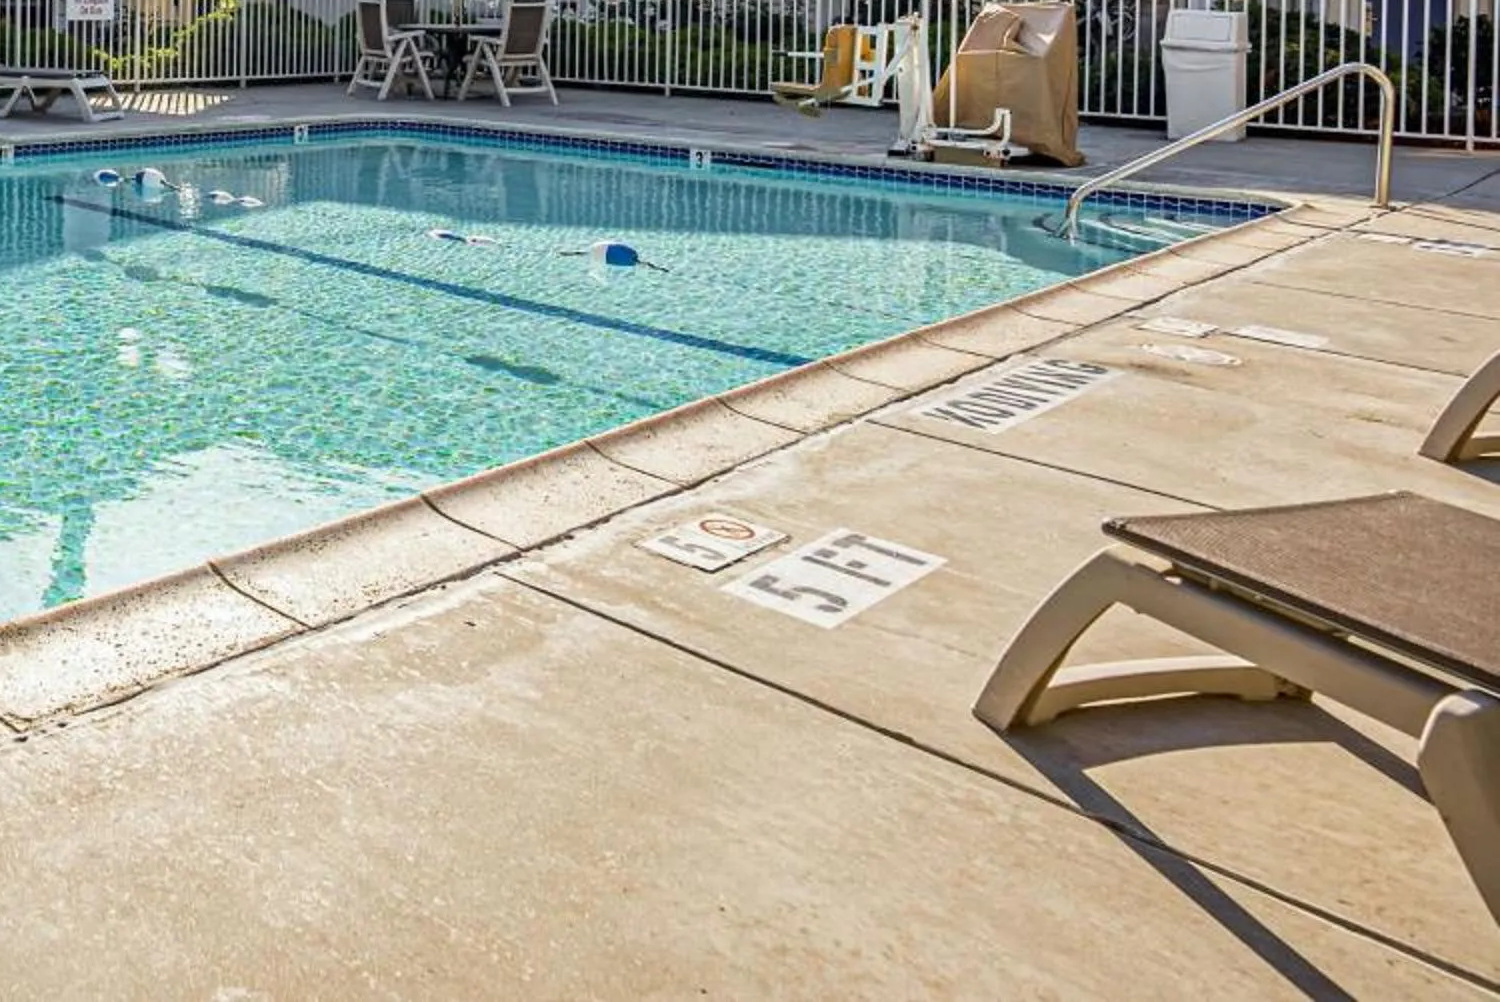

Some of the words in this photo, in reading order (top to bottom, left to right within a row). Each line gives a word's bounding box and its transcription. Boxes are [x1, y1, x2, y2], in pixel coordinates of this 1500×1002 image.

[968, 359, 1109, 411] DIVING
[921, 400, 1016, 429] NO
[659, 535, 727, 561] 5
[749, 574, 848, 613] 5
[802, 534, 927, 587] FT
